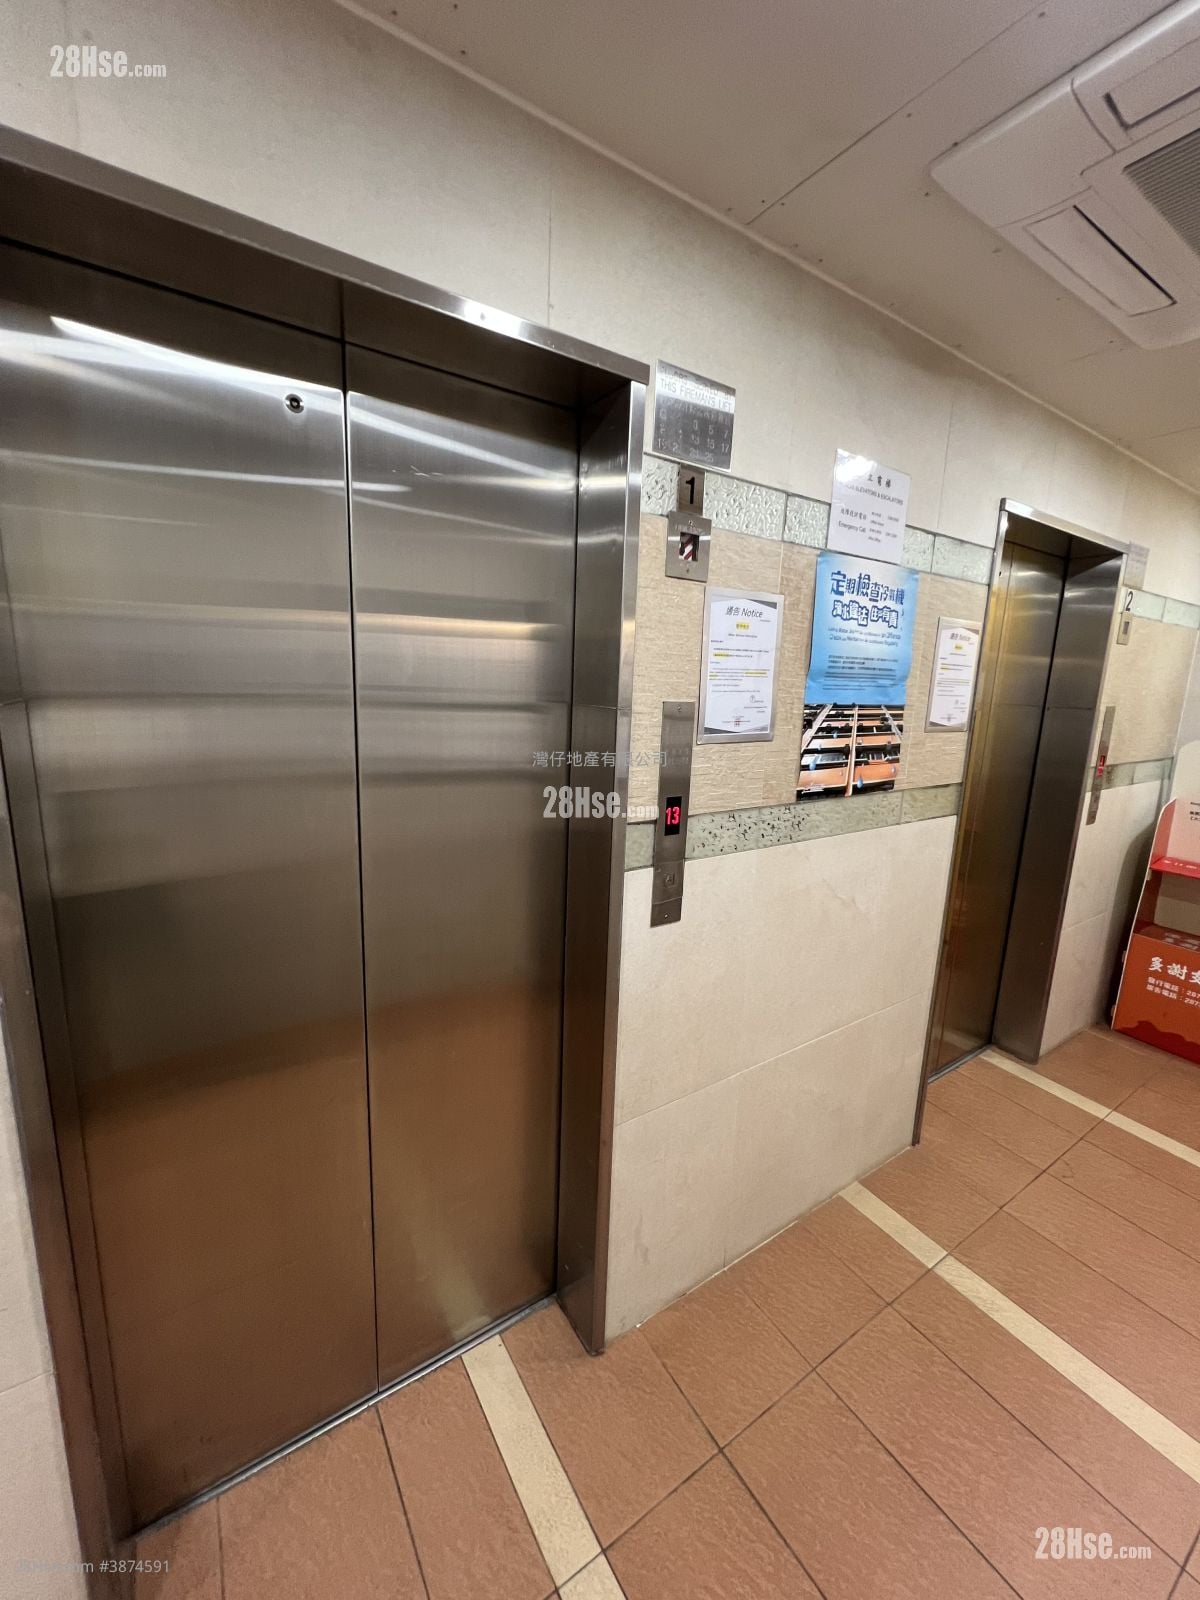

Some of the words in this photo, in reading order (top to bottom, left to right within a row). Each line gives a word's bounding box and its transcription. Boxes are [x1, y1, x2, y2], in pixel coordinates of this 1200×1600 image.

[685, 476, 696, 505] 1
[1125, 590, 1134, 612] 2
[740, 607, 763, 619] Notice
[665, 806, 680, 826] 13
